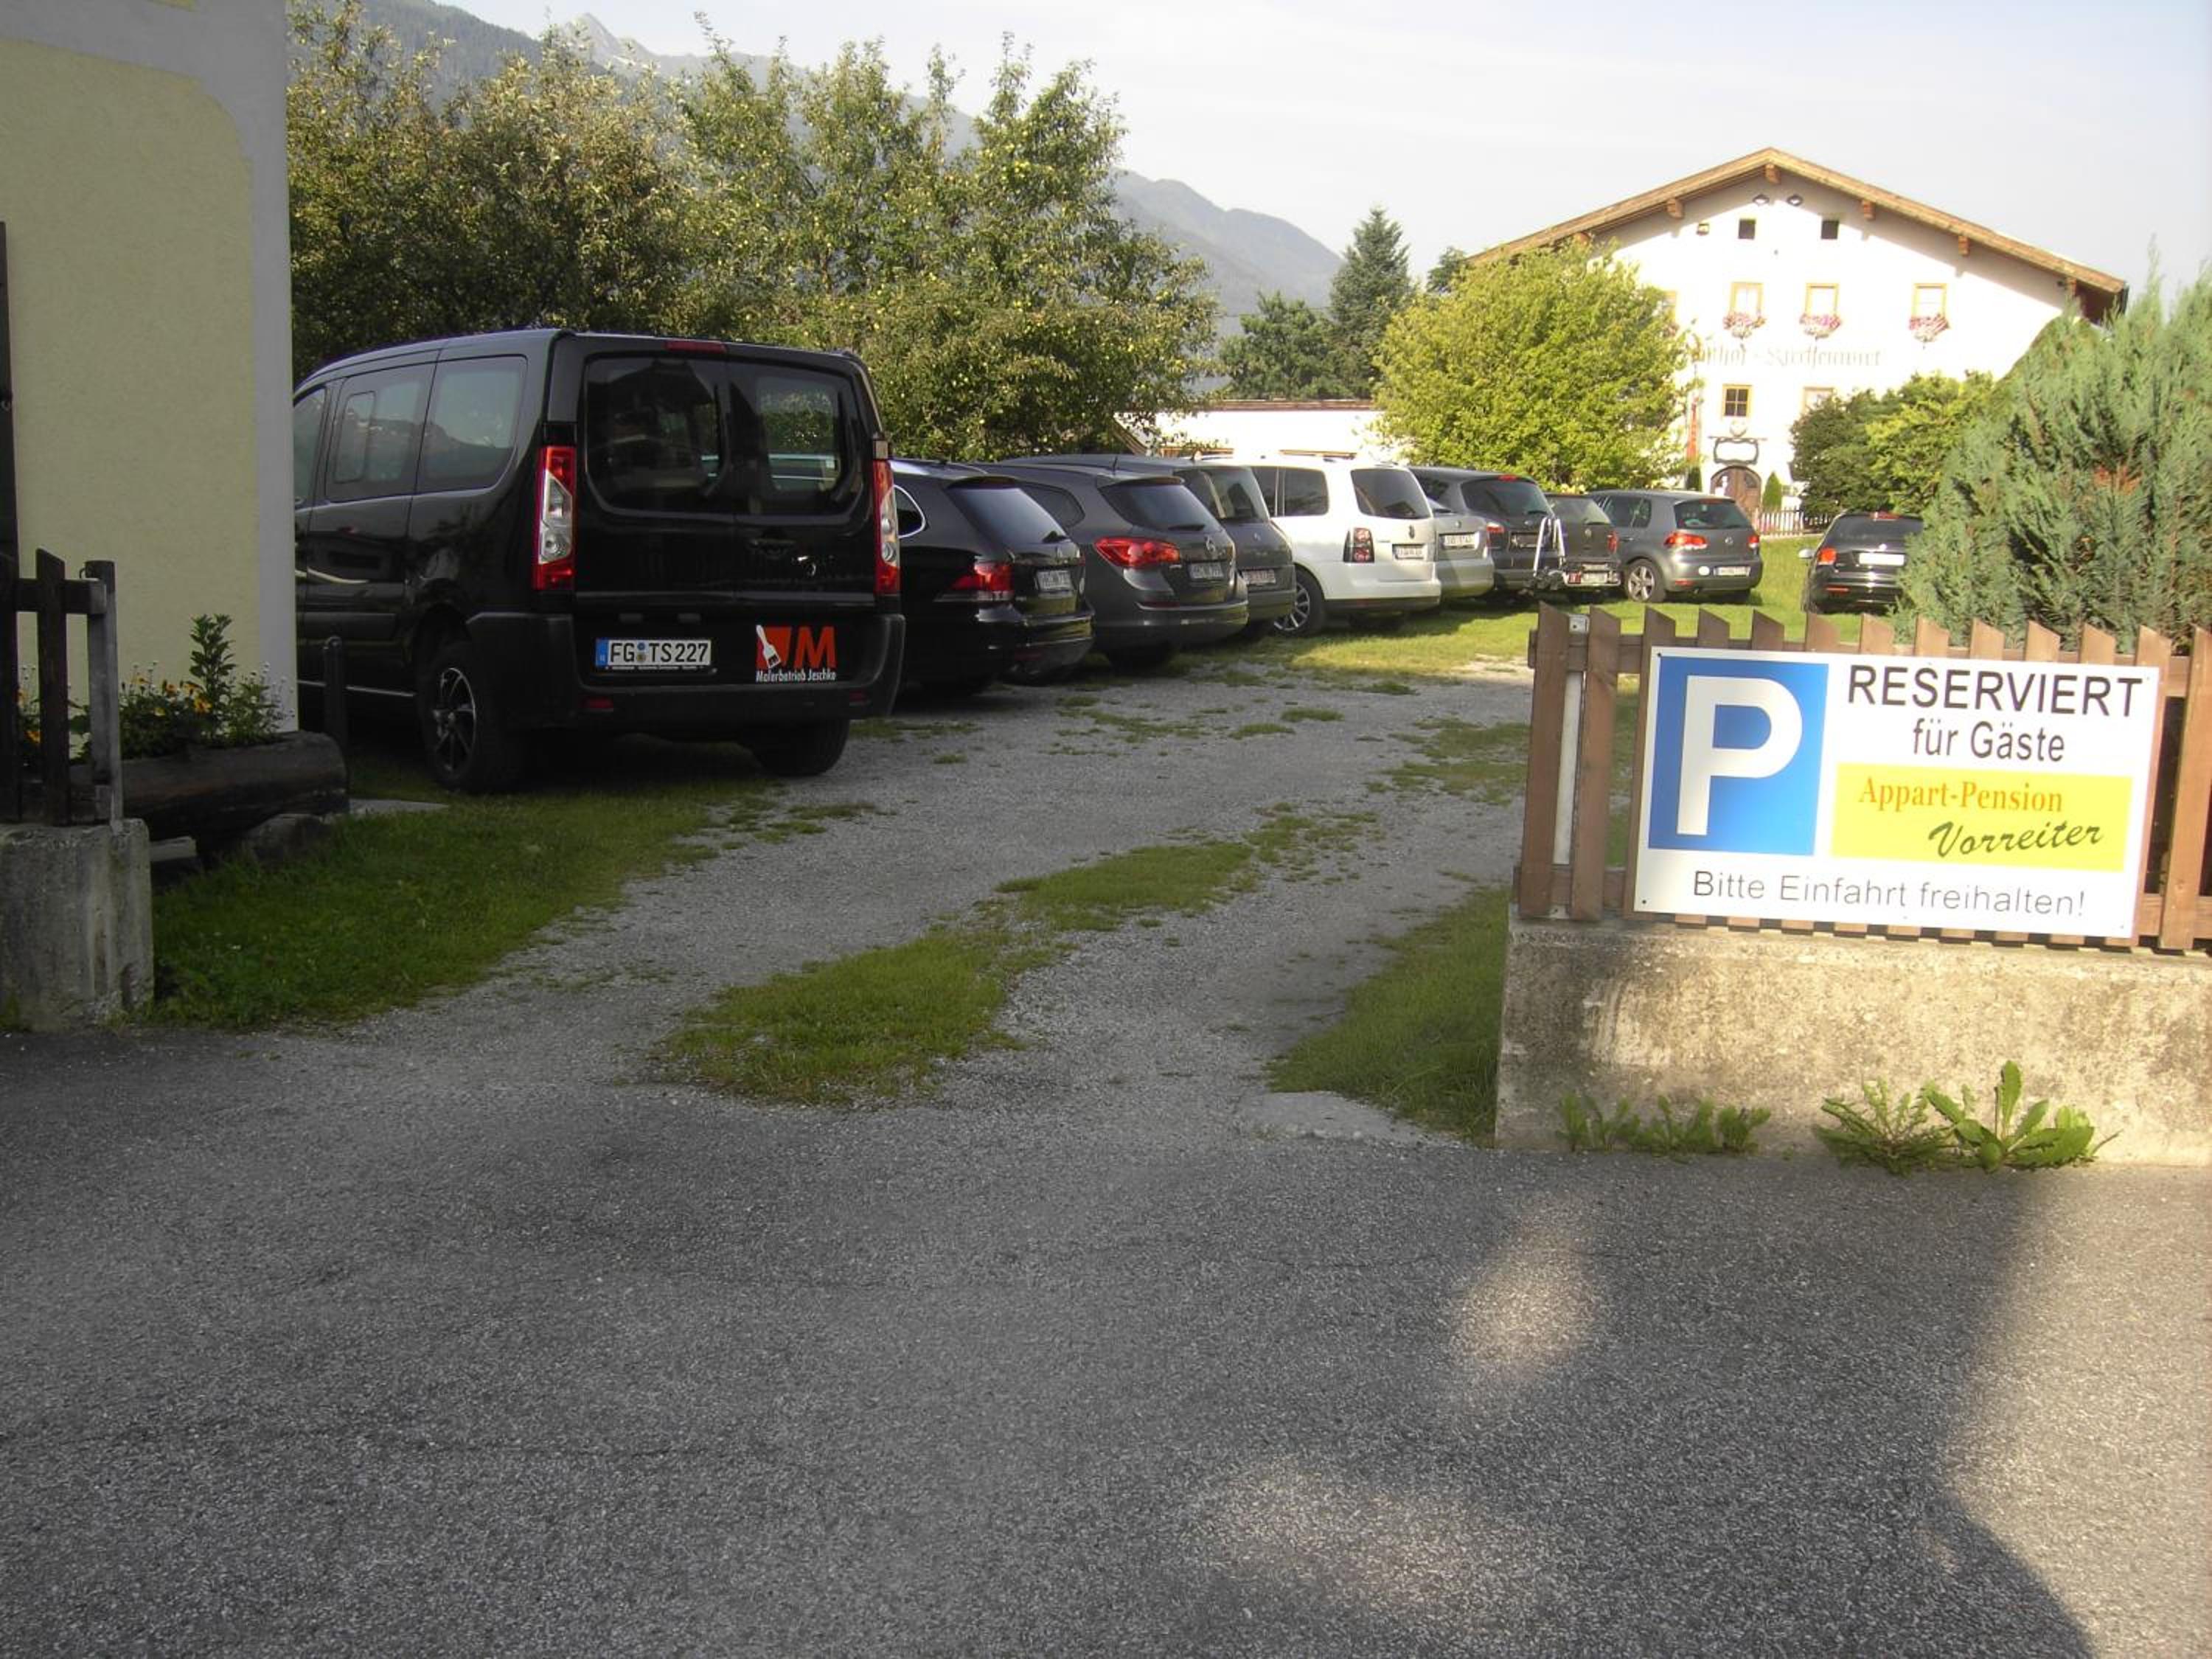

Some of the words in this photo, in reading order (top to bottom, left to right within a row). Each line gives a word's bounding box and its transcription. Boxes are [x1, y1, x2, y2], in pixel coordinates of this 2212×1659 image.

[611, 642, 635, 662] FG
[1848, 664, 2143, 717] RESERVIERT
[1676, 675, 1804, 835] P
[1913, 719, 1958, 756] für
[1970, 720, 2065, 762] Gäste
[1859, 777, 2063, 813] Appart-Pension
[1927, 819, 2104, 858] Vorreiter
[1693, 869, 1765, 900] Bitte
[1781, 874, 1906, 908] Einfahrt
[1921, 880, 2085, 917] freihalten!
